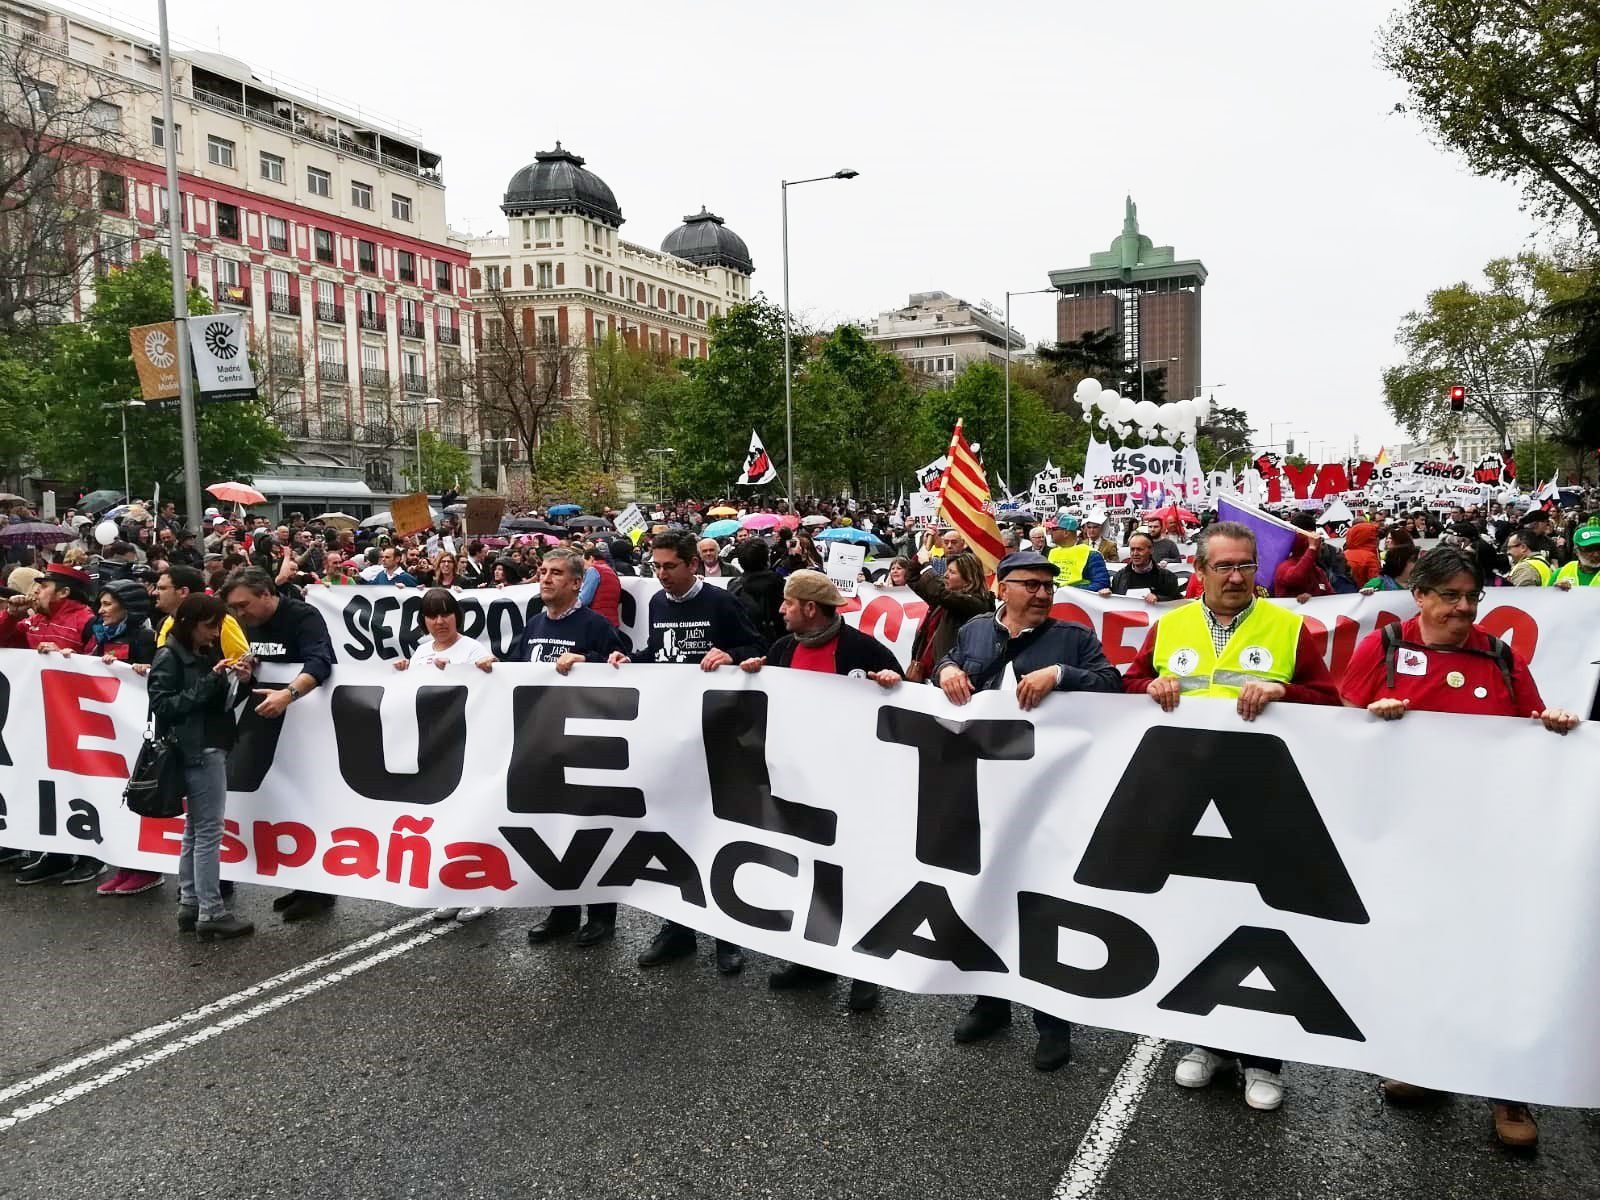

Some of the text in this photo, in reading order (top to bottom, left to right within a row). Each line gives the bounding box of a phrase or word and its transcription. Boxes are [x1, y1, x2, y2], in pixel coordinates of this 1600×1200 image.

[1112, 453, 1185, 475] #Sori
[1423, 461, 1453, 471] SORIA
[1039, 483, 1058, 495] 8,6
[685, 628, 704, 640] JAÉN
[39, 780, 103, 844] la
[498, 826, 1366, 1042] VACIADA
